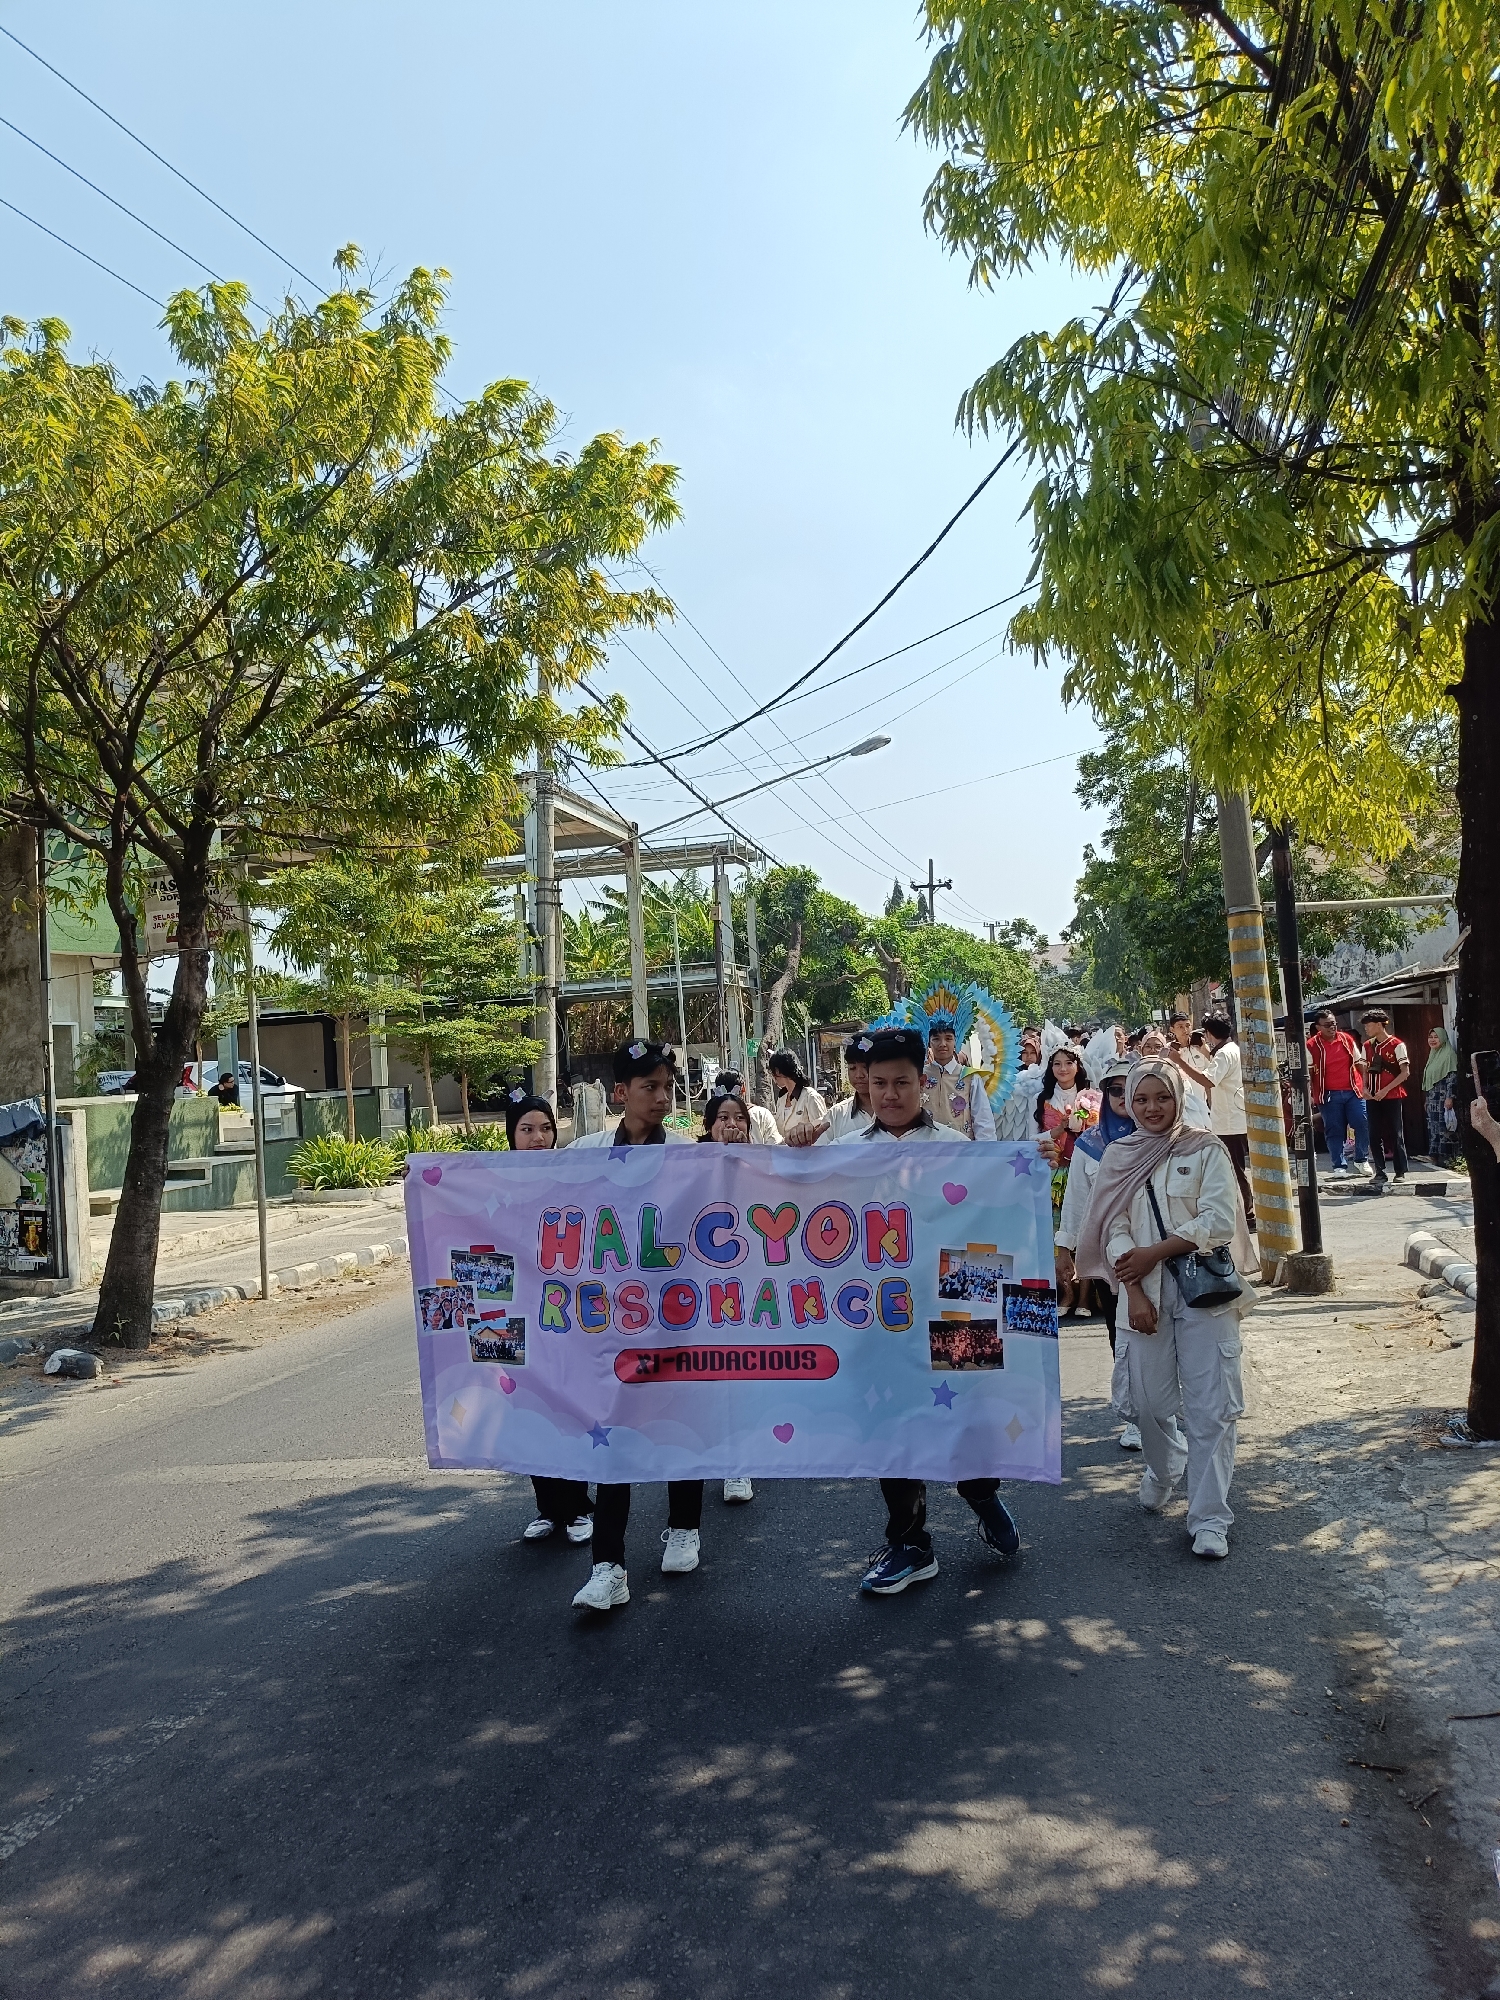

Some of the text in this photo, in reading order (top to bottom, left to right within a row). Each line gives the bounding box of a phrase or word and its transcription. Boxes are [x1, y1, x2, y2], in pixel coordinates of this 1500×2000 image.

[537, 1200, 913, 1276] HALCYON
[538, 1276, 914, 1335] RESONANCE
[635, 1350, 818, 1375] XI-AUDACIOUS
